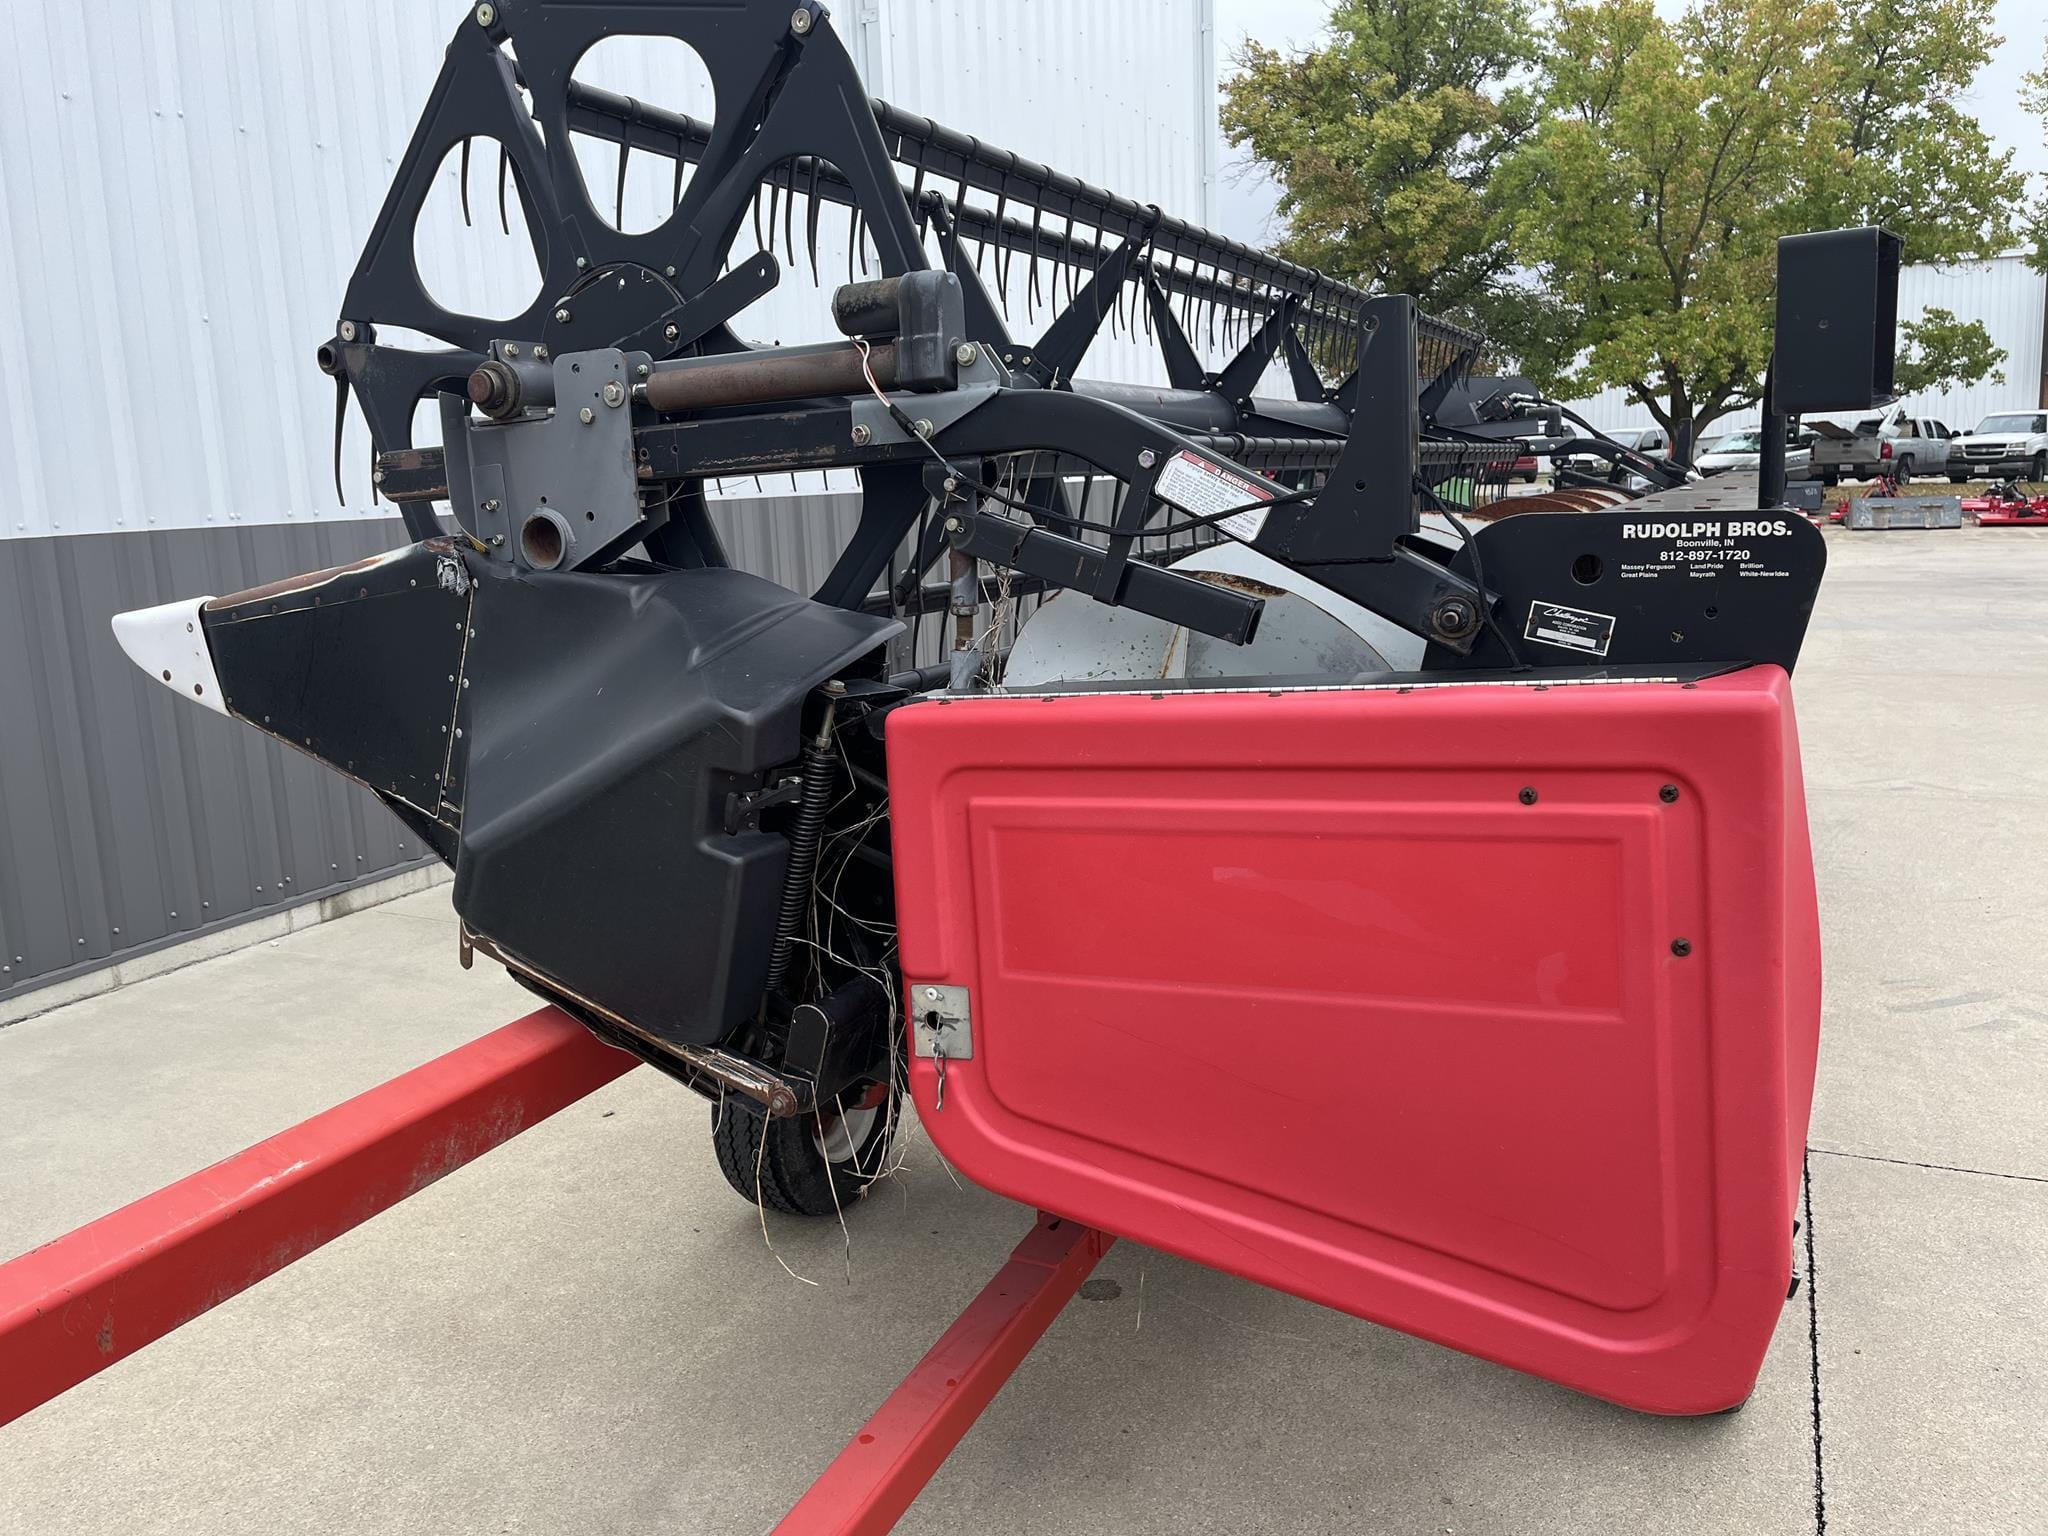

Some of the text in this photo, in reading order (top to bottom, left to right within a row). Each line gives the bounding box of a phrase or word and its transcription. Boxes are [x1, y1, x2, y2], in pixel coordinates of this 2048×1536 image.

[1214, 468, 1250, 490] DANGER
[1622, 520, 1793, 539] RUDOLPH BROS.
[1676, 538, 1735, 548] Boonville, IN
[1659, 549, 1751, 561] 812-897-1720
[1621, 563, 1676, 572] Massey Ferguson
[1690, 562, 1724, 570] Land Pride
[1739, 562, 1765, 570] Brillion
[1621, 571, 1658, 579] Great Plains
[1689, 570, 1716, 579] Mayrath
